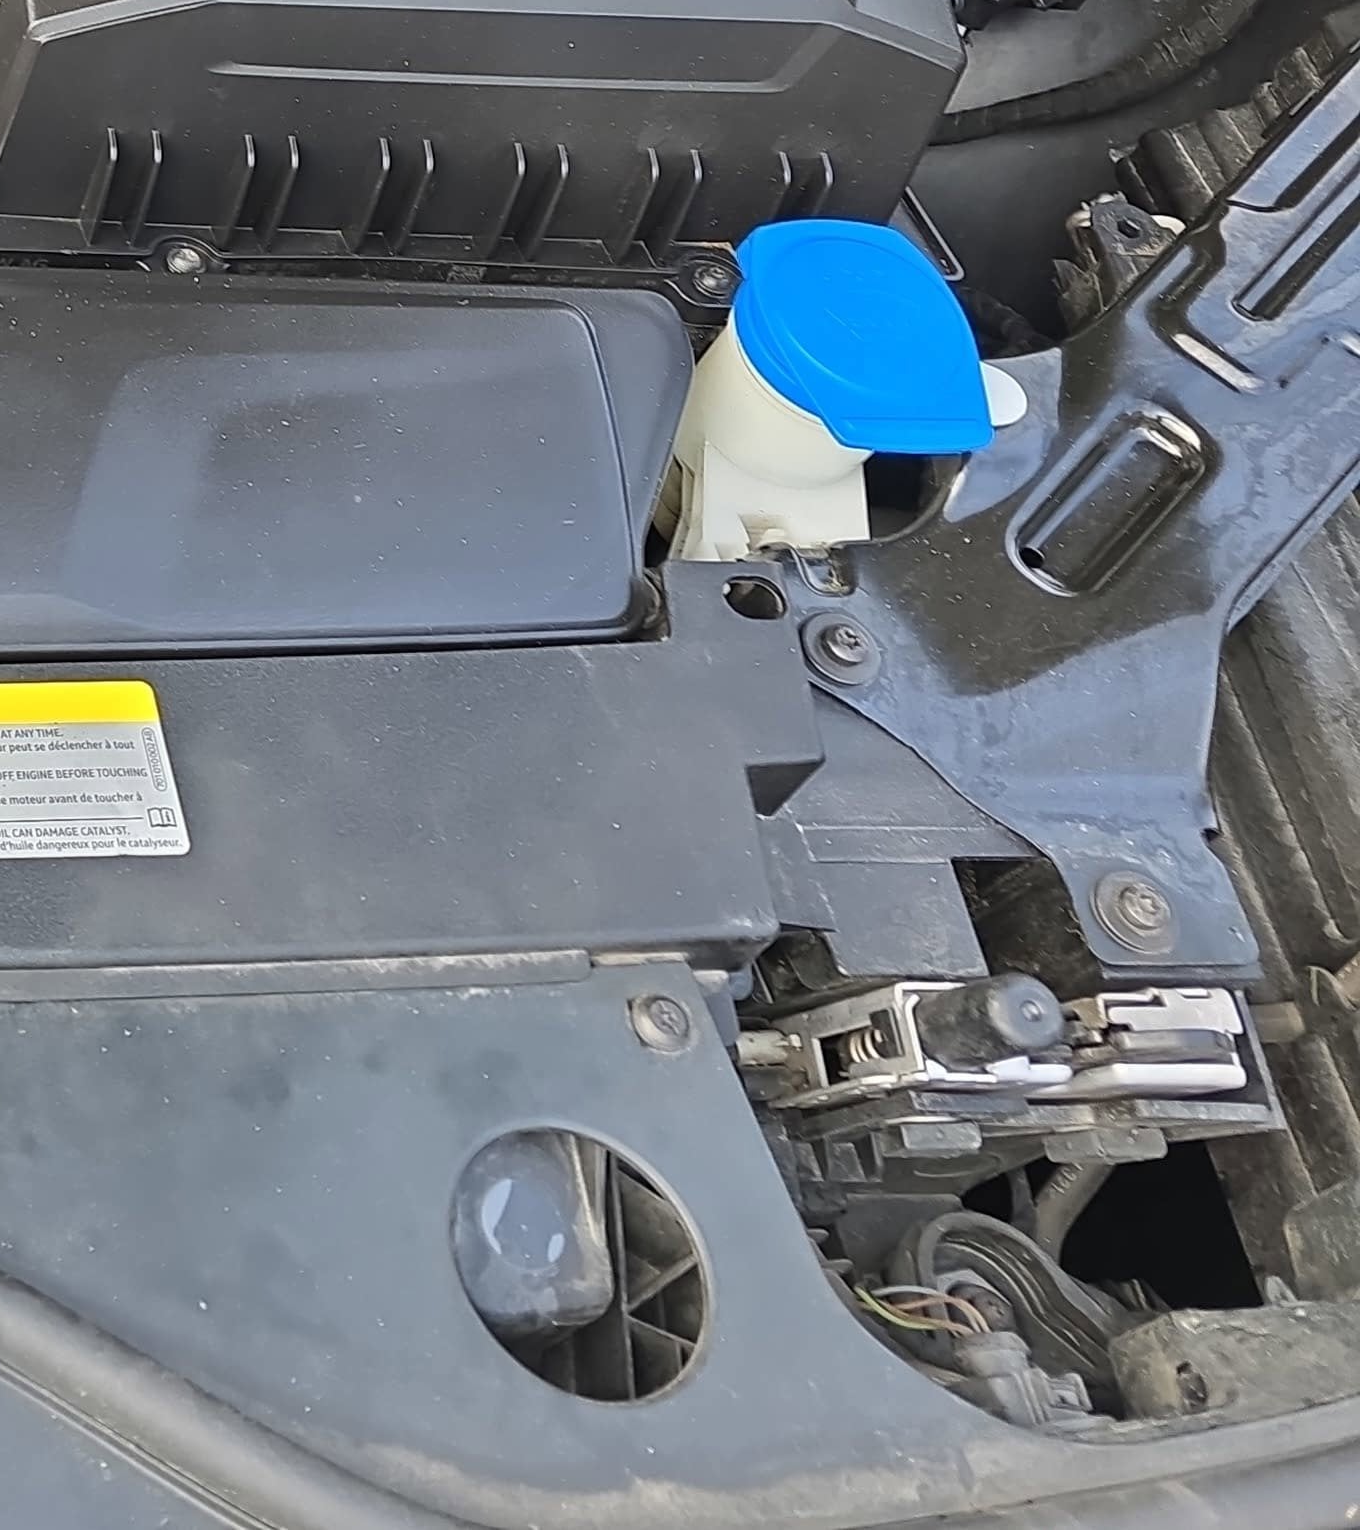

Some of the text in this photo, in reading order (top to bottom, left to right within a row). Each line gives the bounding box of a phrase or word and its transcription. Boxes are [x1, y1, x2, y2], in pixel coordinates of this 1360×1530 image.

[0, 730, 12, 738] AT
[14, 729, 34, 738] ANY
[9, 743, 32, 754] peut
[34, 743, 46, 751] se
[48, 740, 103, 751] déclencher
[105, 739, 112, 749] à
[113, 740, 135, 749] tout
[17, 770, 54, 780] ENGINE
[55, 769, 97, 779] BEFORE
[98, 768, 148, 777] TOUCHING
[9, 794, 46, 805] moteur
[48, 793, 77, 803] avant
[80, 792, 92, 802] de
[94, 792, 134, 802] toucher
[136, 790, 142, 801] à
[11, 828, 33, 837] CAN
[35, 827, 79, 837] DAMAGE
[80, 826, 130, 836] CATALYST.
[0, 840, 34, 851] d'huile
[35, 840, 89, 852] dangereux
[92, 841, 115, 850] pour
[117, 838, 127, 848] le
[128, 838, 182, 849] catalyseur.
